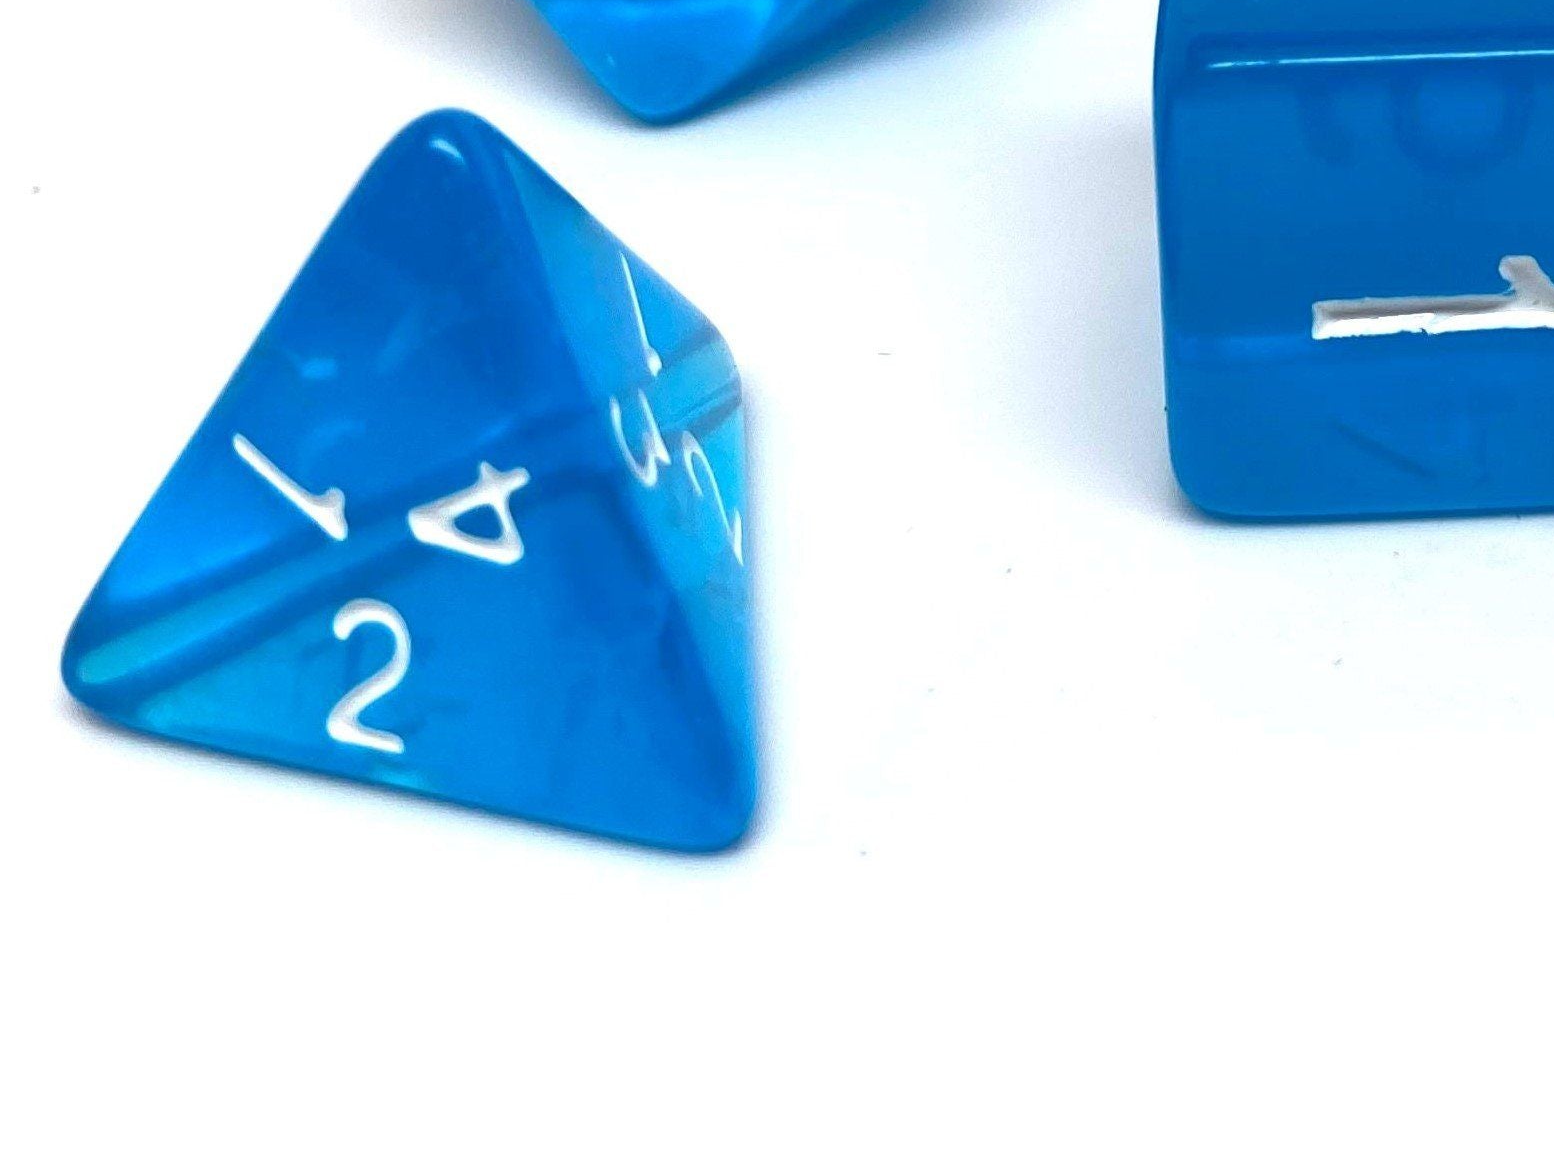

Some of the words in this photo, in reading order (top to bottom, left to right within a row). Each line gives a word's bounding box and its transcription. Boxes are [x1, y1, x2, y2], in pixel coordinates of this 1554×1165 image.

[233, 432, 348, 540] 1
[407, 461, 530, 565] 4
[326, 597, 412, 754] 2
